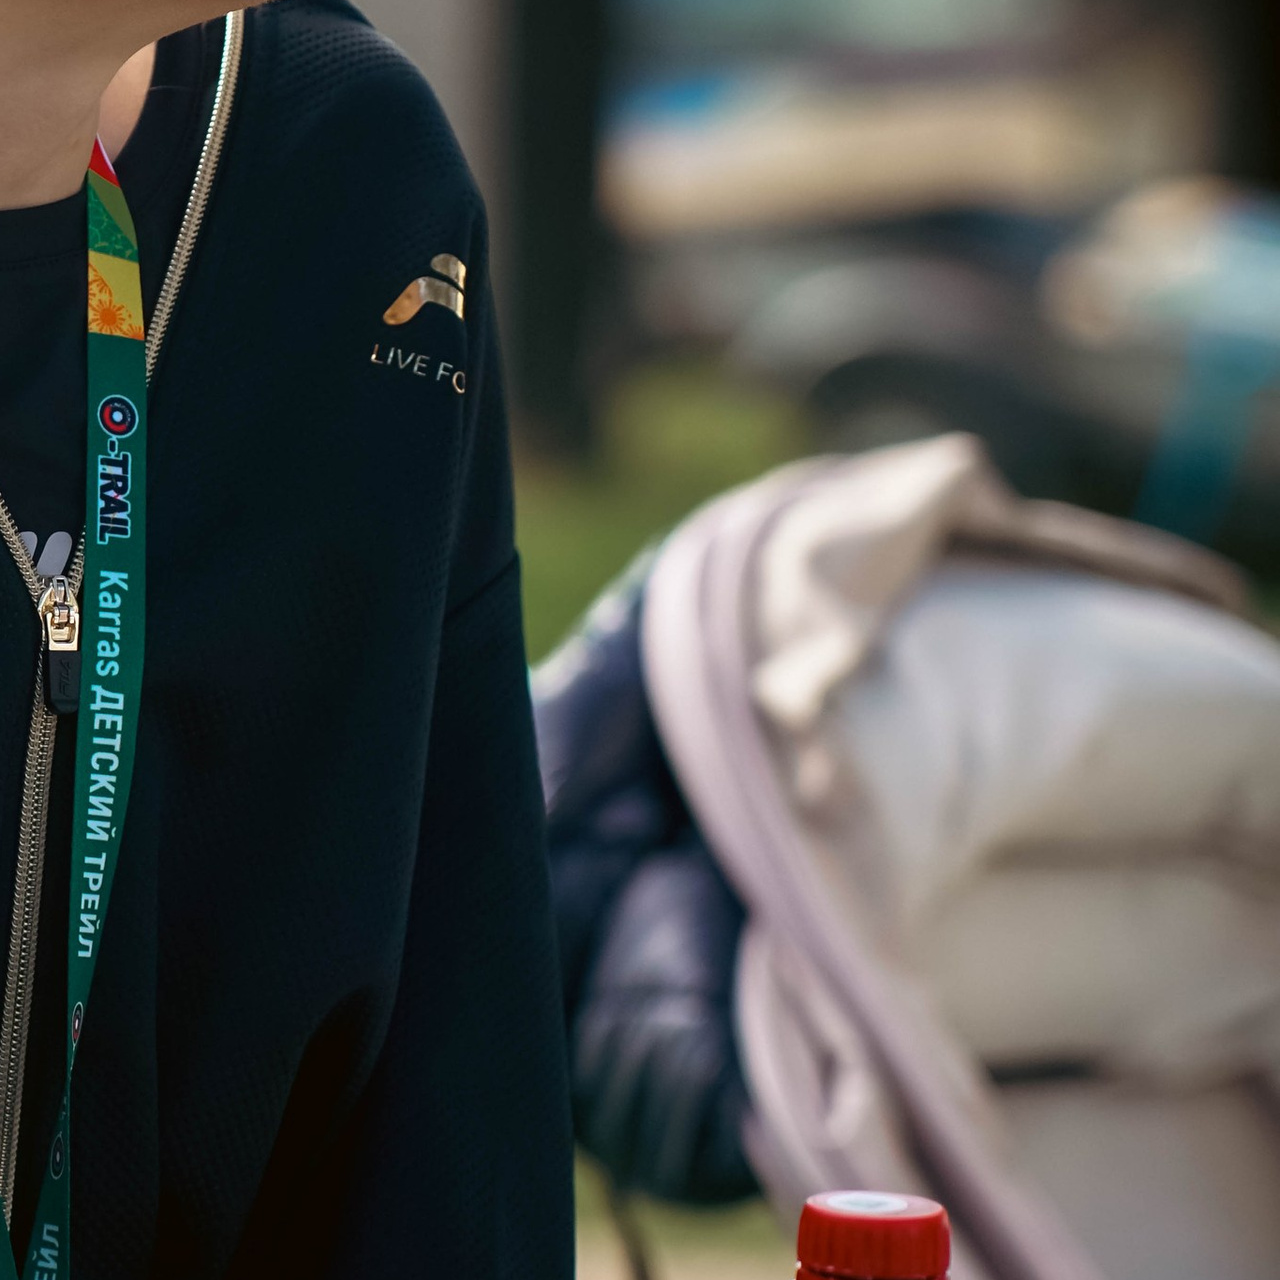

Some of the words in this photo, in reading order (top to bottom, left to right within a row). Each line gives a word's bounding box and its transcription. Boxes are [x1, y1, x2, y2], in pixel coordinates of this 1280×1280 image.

[370, 343, 430, 377] LIVE
[97, 394, 139, 545] O-TRAIL
[95, 570, 129, 678] Karras
[84, 684, 126, 842] ДЕТСКИЙ
[77, 852, 108, 959] ТРЕЙЛ
